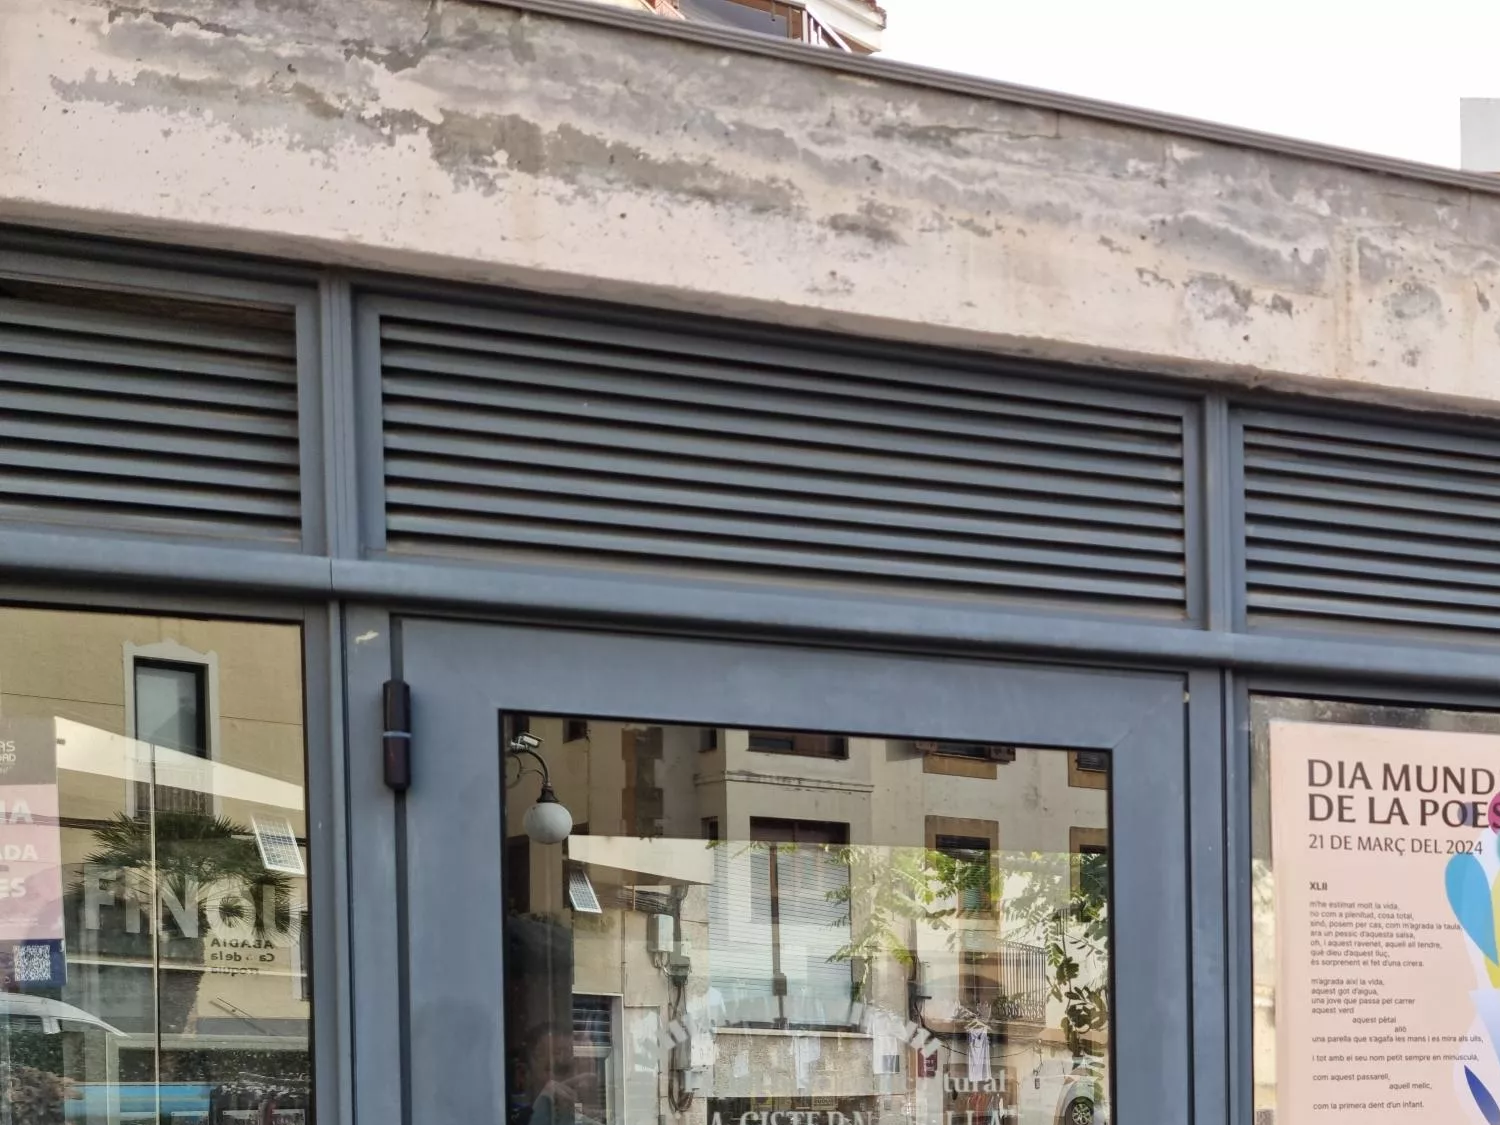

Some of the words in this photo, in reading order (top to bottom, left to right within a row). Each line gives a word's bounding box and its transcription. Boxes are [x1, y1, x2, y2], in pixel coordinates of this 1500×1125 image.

[1308, 759, 1373, 790] DIA
[1308, 793, 1356, 823] DE
[1368, 796, 1409, 826] LA
[1309, 834, 1324, 849] 21
[1330, 835, 1352, 851] DE
[1357, 836, 1405, 856] MARÇ
[1411, 839, 1442, 854] DEL
[1446, 840, 1483, 855] 2024
